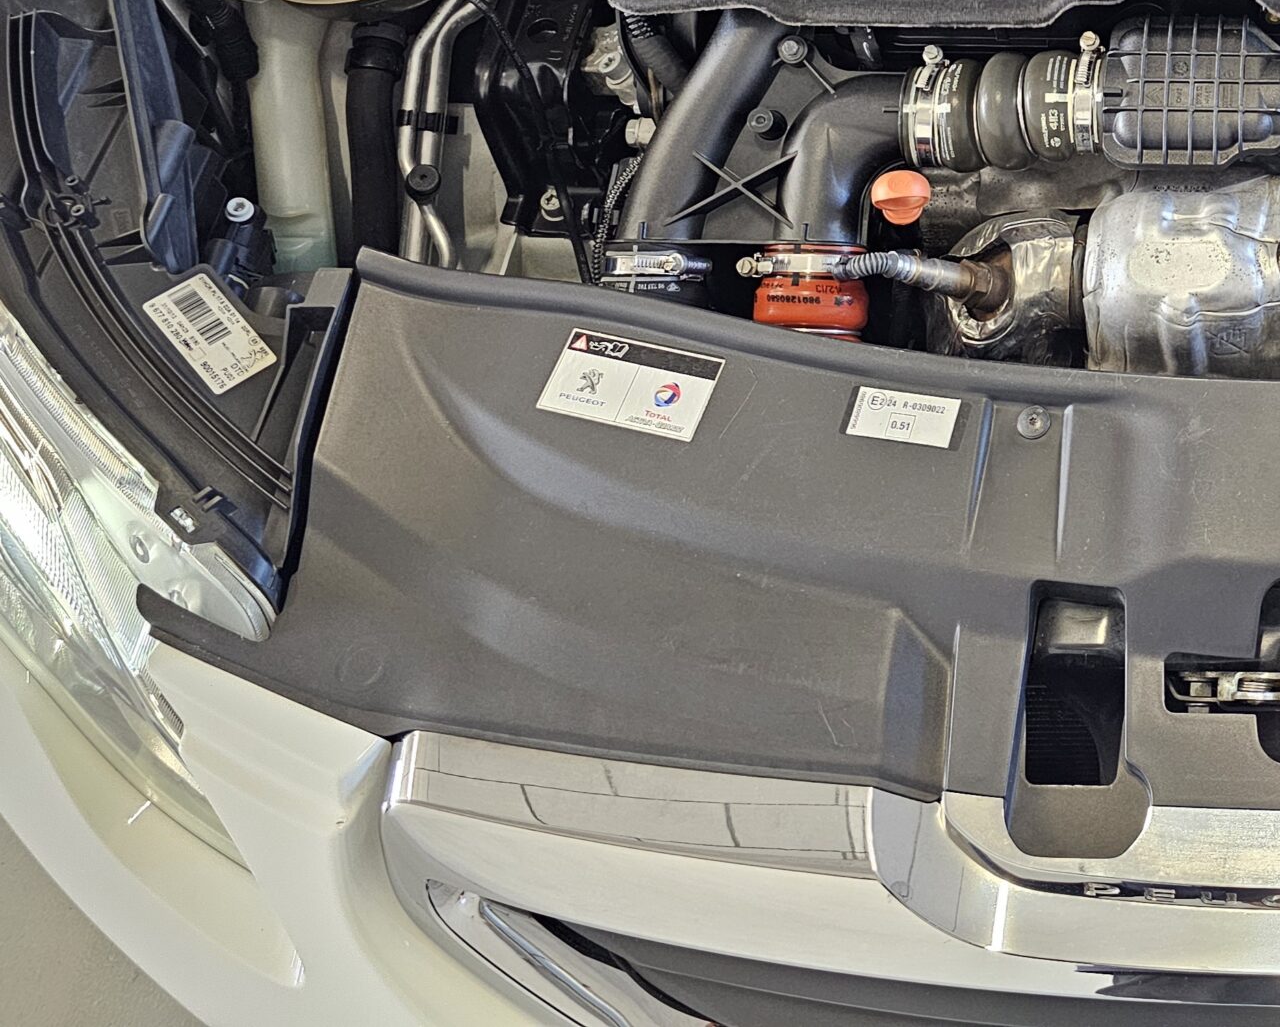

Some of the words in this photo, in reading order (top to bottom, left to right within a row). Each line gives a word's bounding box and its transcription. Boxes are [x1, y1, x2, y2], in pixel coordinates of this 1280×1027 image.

[153, 307, 165, 318] 677
[200, 360, 228, 390] 90015176
[559, 392, 607, 408] PEUGEOT
[644, 409, 673, 423] TOTAL
[890, 420, 911, 431] 0.51
